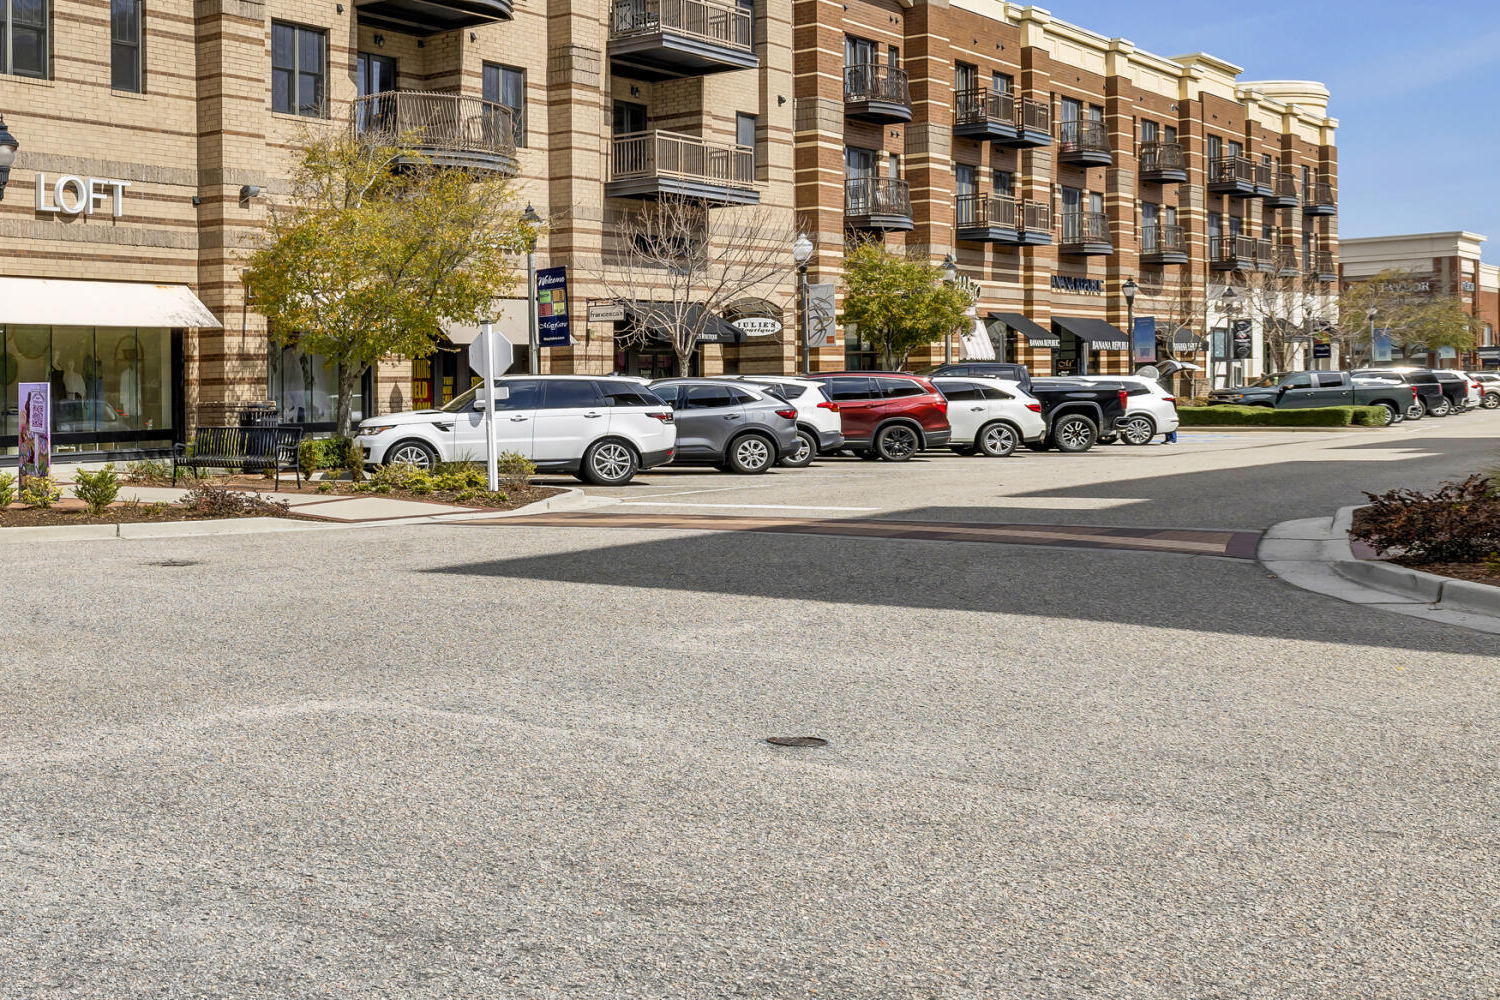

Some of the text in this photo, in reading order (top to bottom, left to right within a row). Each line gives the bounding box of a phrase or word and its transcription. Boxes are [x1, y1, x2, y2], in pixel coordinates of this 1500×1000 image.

[35, 173, 132, 217] LOFT
[1092, 340, 1129, 350] BANANA REPUBLI
